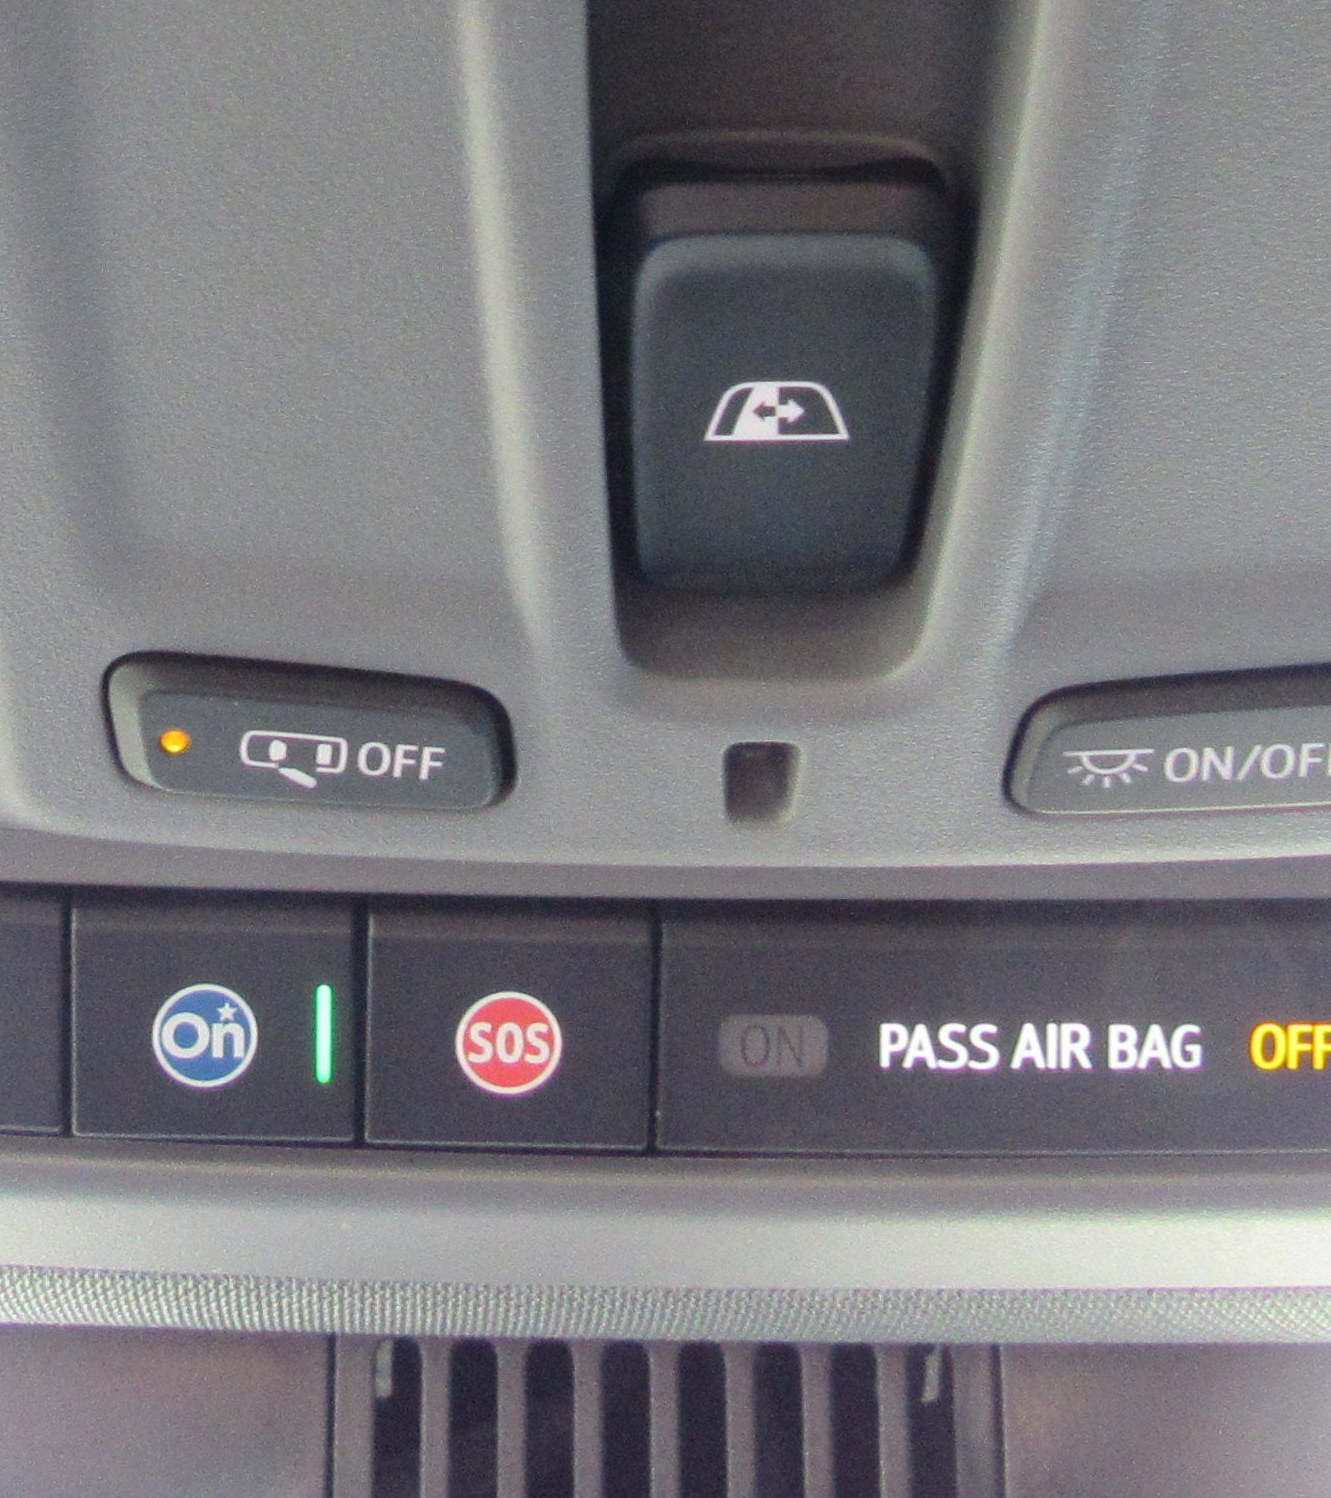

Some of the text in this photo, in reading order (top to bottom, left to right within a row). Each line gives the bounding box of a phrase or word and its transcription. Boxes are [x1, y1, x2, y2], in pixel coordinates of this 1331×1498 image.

[357, 741, 447, 781] OFF
[161, 1011, 246, 1060] On
[467, 1021, 551, 1065] SOS
[739, 1024, 807, 1070] ON
[878, 1022, 1000, 1071] PASS
[1010, 1022, 1093, 1071] AIR
[1107, 1023, 1203, 1071] BAG
